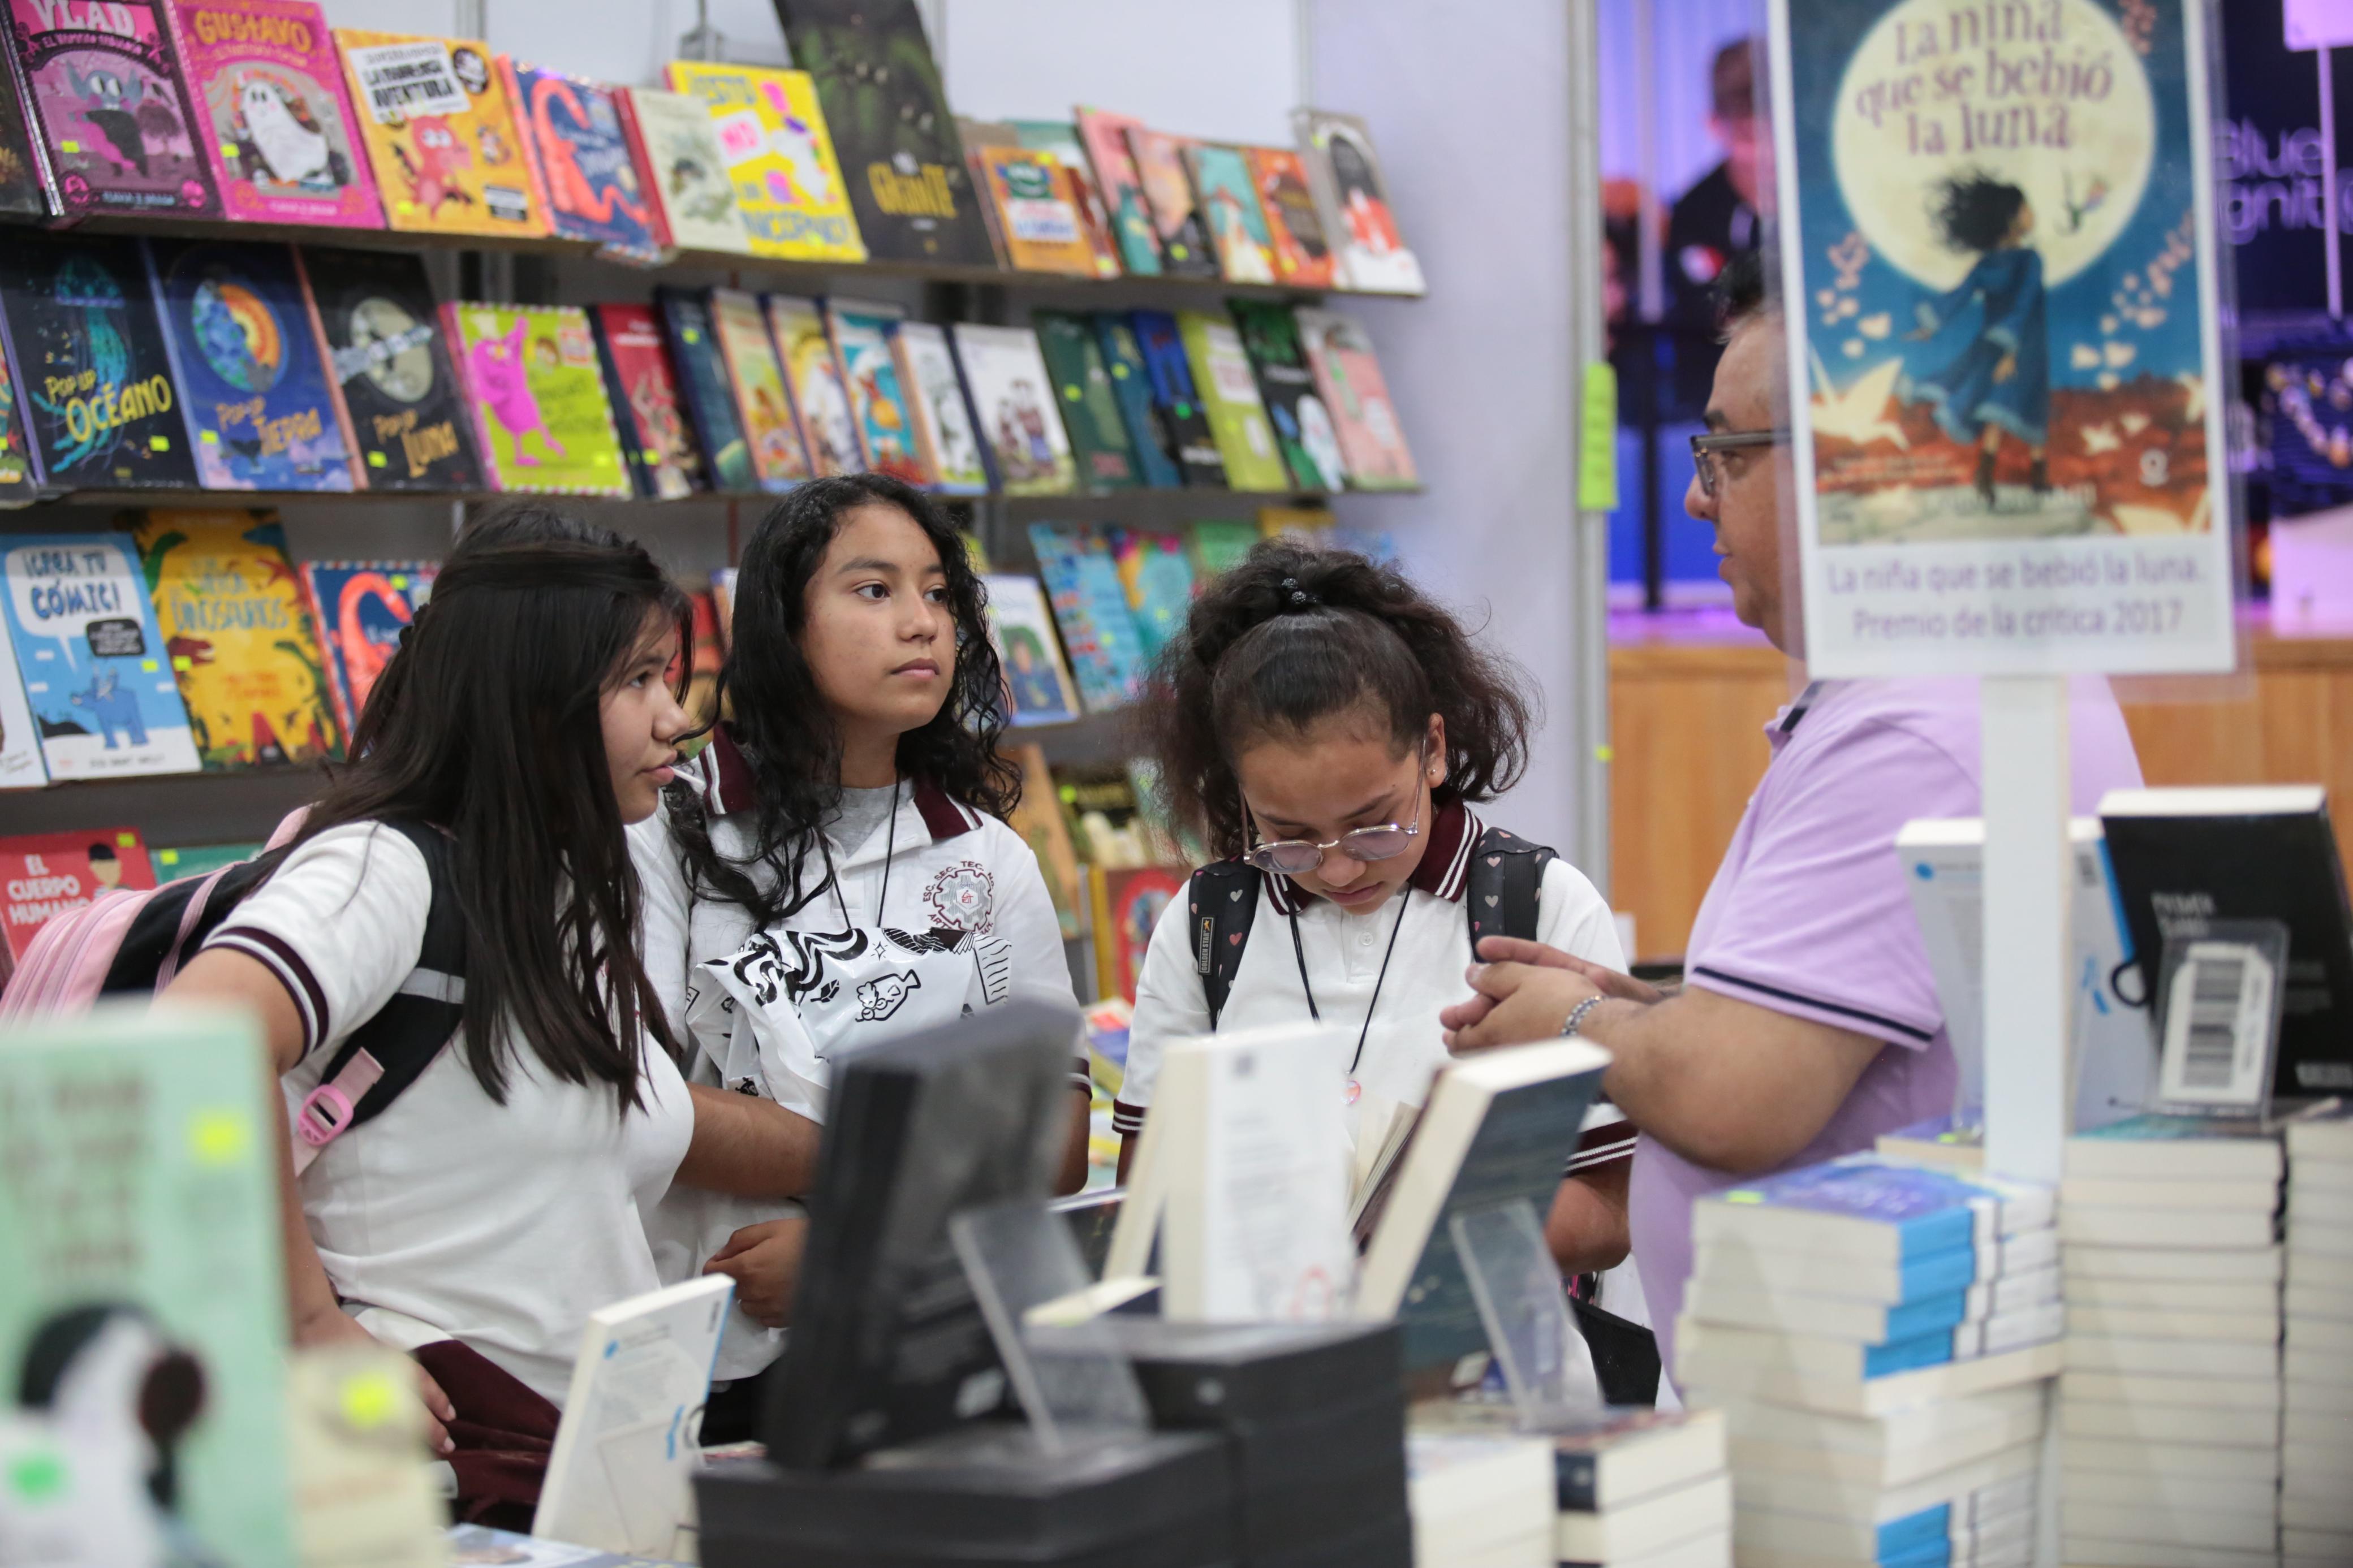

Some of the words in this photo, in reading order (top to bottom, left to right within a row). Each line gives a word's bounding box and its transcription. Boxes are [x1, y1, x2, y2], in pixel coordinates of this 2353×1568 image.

[195, 10, 312, 53] GUSTAVO
[1894, 19, 1942, 66] La
[1855, 74, 1924, 128] que
[1932, 66, 1975, 103] se
[1984, 48, 2114, 103] bebió
[1905, 113, 1948, 156] la
[1958, 106, 2075, 154] luna
[65, 374, 173, 443] OCÉANO
[31, 578, 120, 620] CÓMIC!
[1853, 607, 1946, 641] Premio
[2111, 598, 2184, 636] 2017
[24, 854, 50, 876] EL
[923, 884, 936, 902] ESC.
[934, 866, 957, 881] SEC.
[960, 861, 984, 871] TEC.
[7, 875, 81, 902] CUERPO
